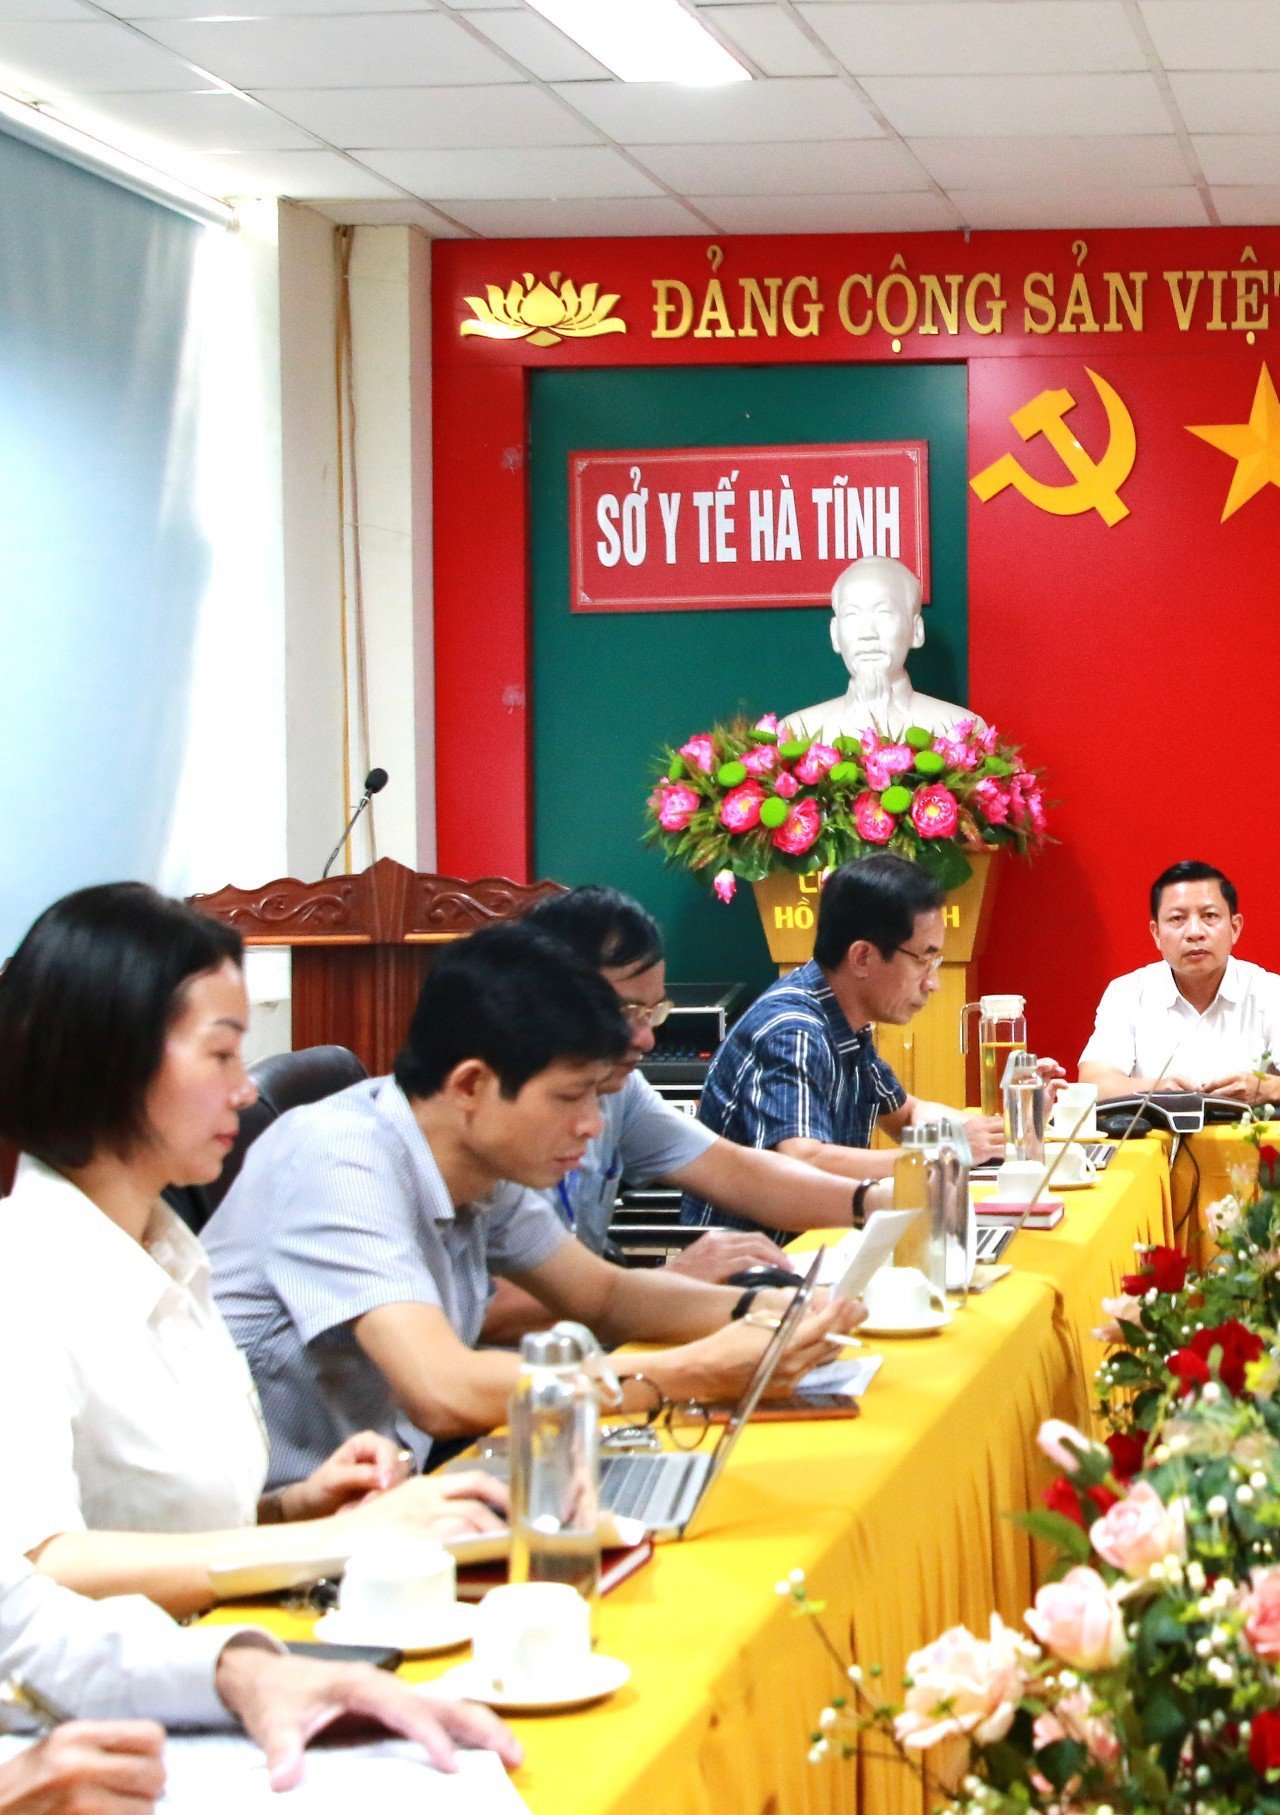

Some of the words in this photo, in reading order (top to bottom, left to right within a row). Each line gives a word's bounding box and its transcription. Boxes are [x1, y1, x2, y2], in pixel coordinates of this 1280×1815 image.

[652, 245, 824, 338] ĐẢNG
[838, 253, 1007, 353] CỘNG
[1023, 240, 1148, 334] SẢN
[597, 466, 649, 567] SỞ
[658, 492, 681, 565] Y
[693, 470, 740, 563] TẾ
[750, 474, 802, 562] HÀ
[812, 474, 900, 560] TĨNH
[774, 896, 815, 930] HỒ
